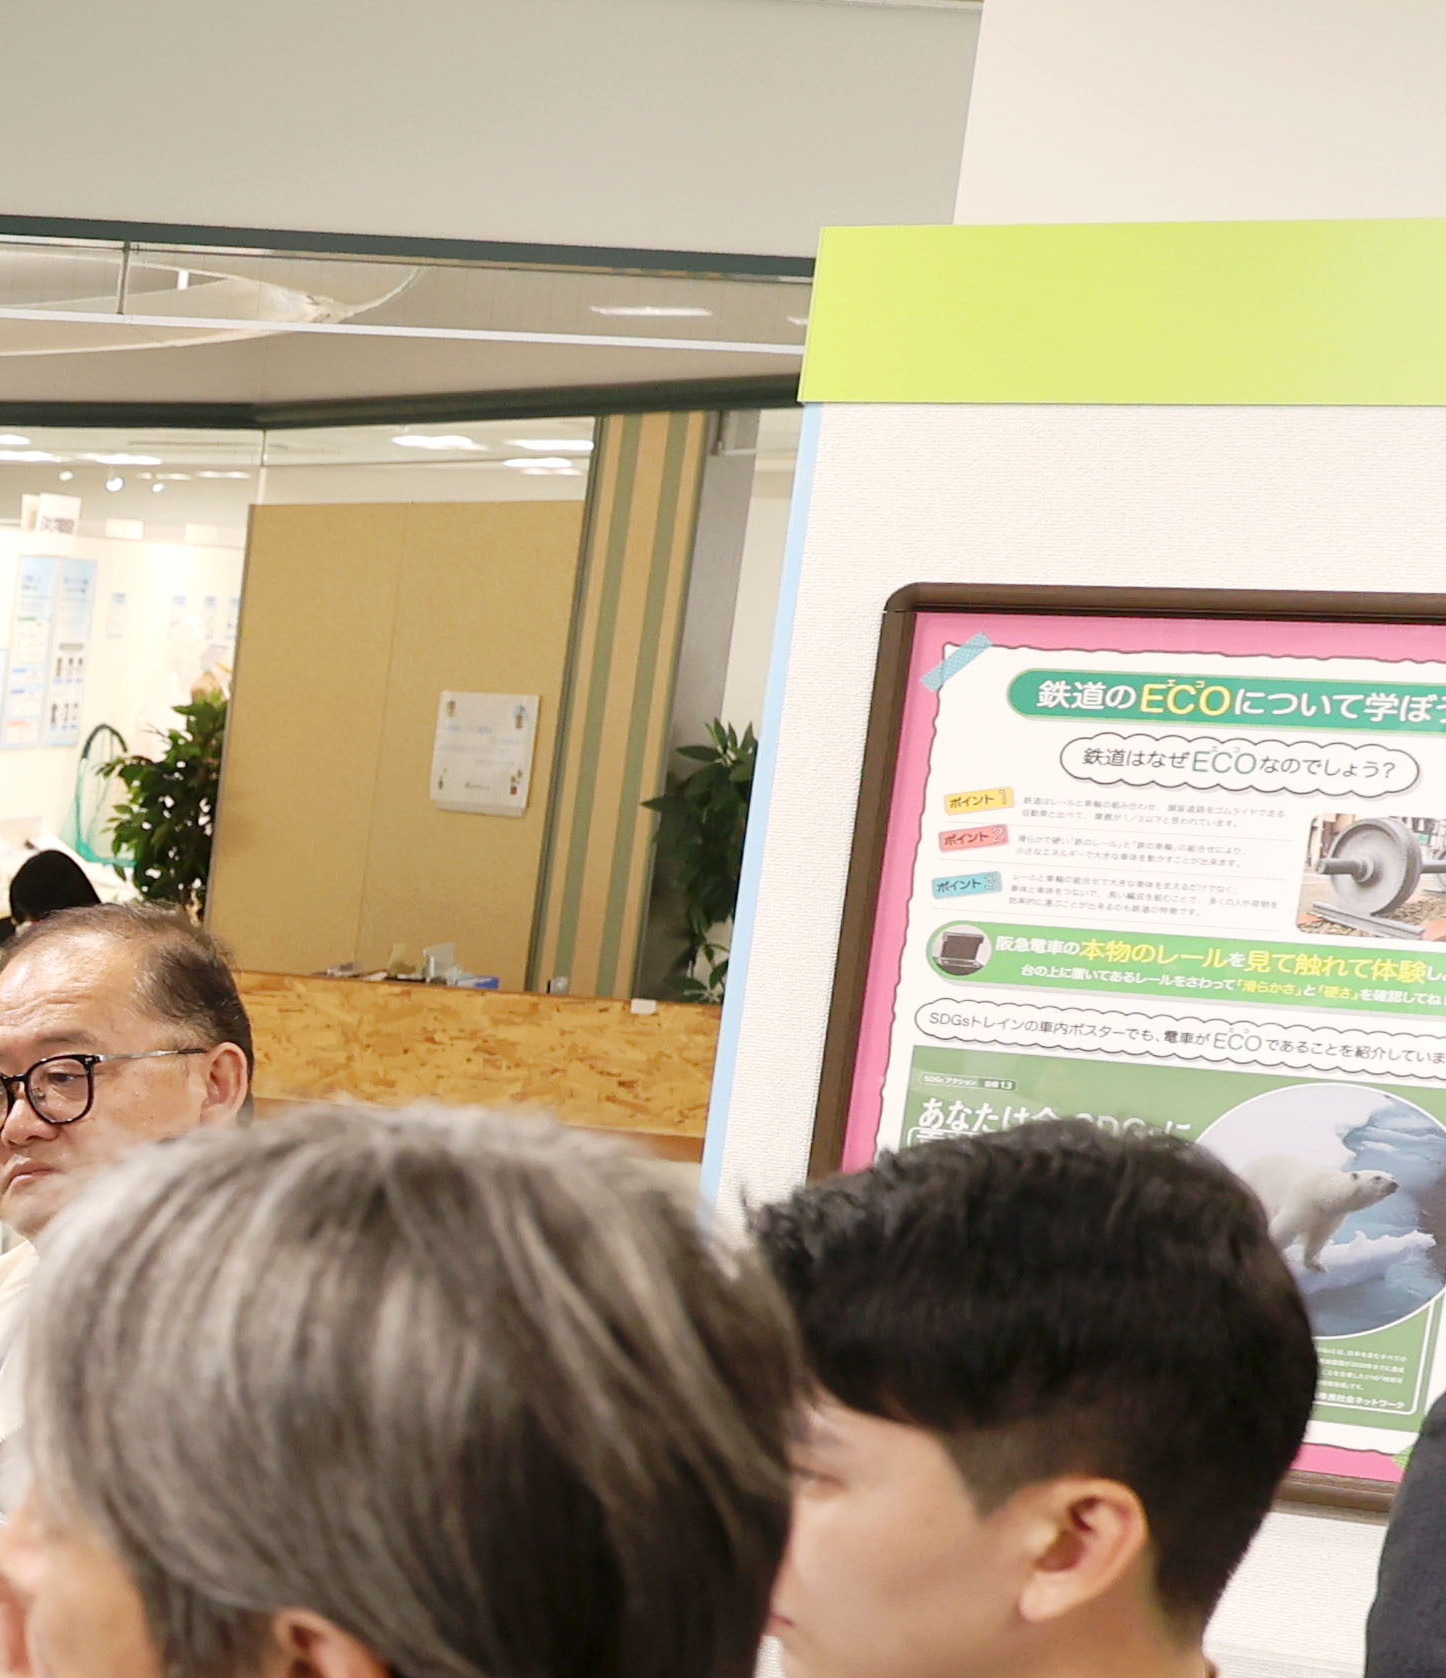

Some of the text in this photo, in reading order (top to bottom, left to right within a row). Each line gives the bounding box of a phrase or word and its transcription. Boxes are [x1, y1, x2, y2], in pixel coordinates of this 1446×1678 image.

[1083, 746, 1396, 780] 鉄道はなぜECOなのでしょう?
[948, 793, 995, 809] ポイント
[943, 831, 990, 847] ポイント
[936, 877, 982, 893] ポイント
